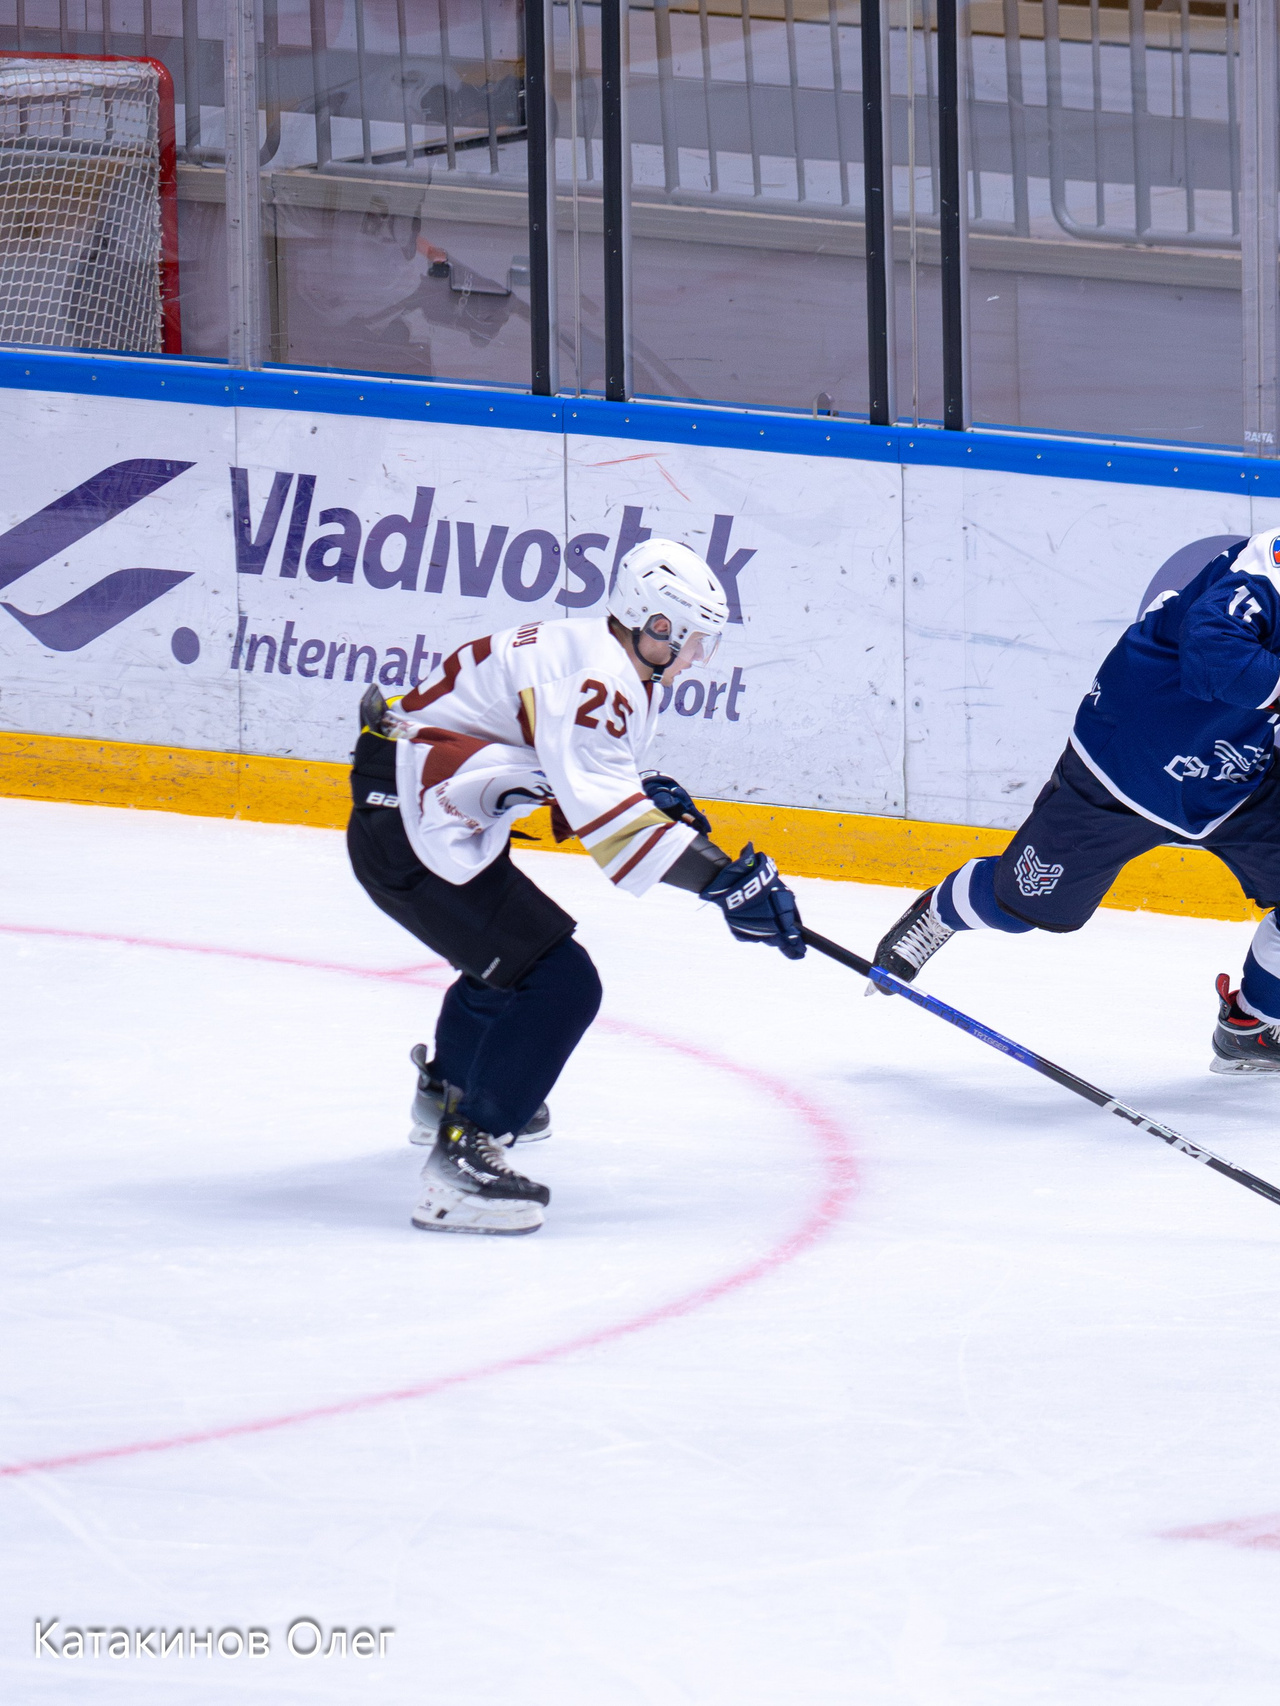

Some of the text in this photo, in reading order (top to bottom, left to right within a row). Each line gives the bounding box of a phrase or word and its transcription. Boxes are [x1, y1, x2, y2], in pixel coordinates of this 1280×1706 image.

[229, 466, 758, 625] Vladivostk
[574, 678, 634, 739] 25
[1102, 1099, 1213, 1165] CCM
